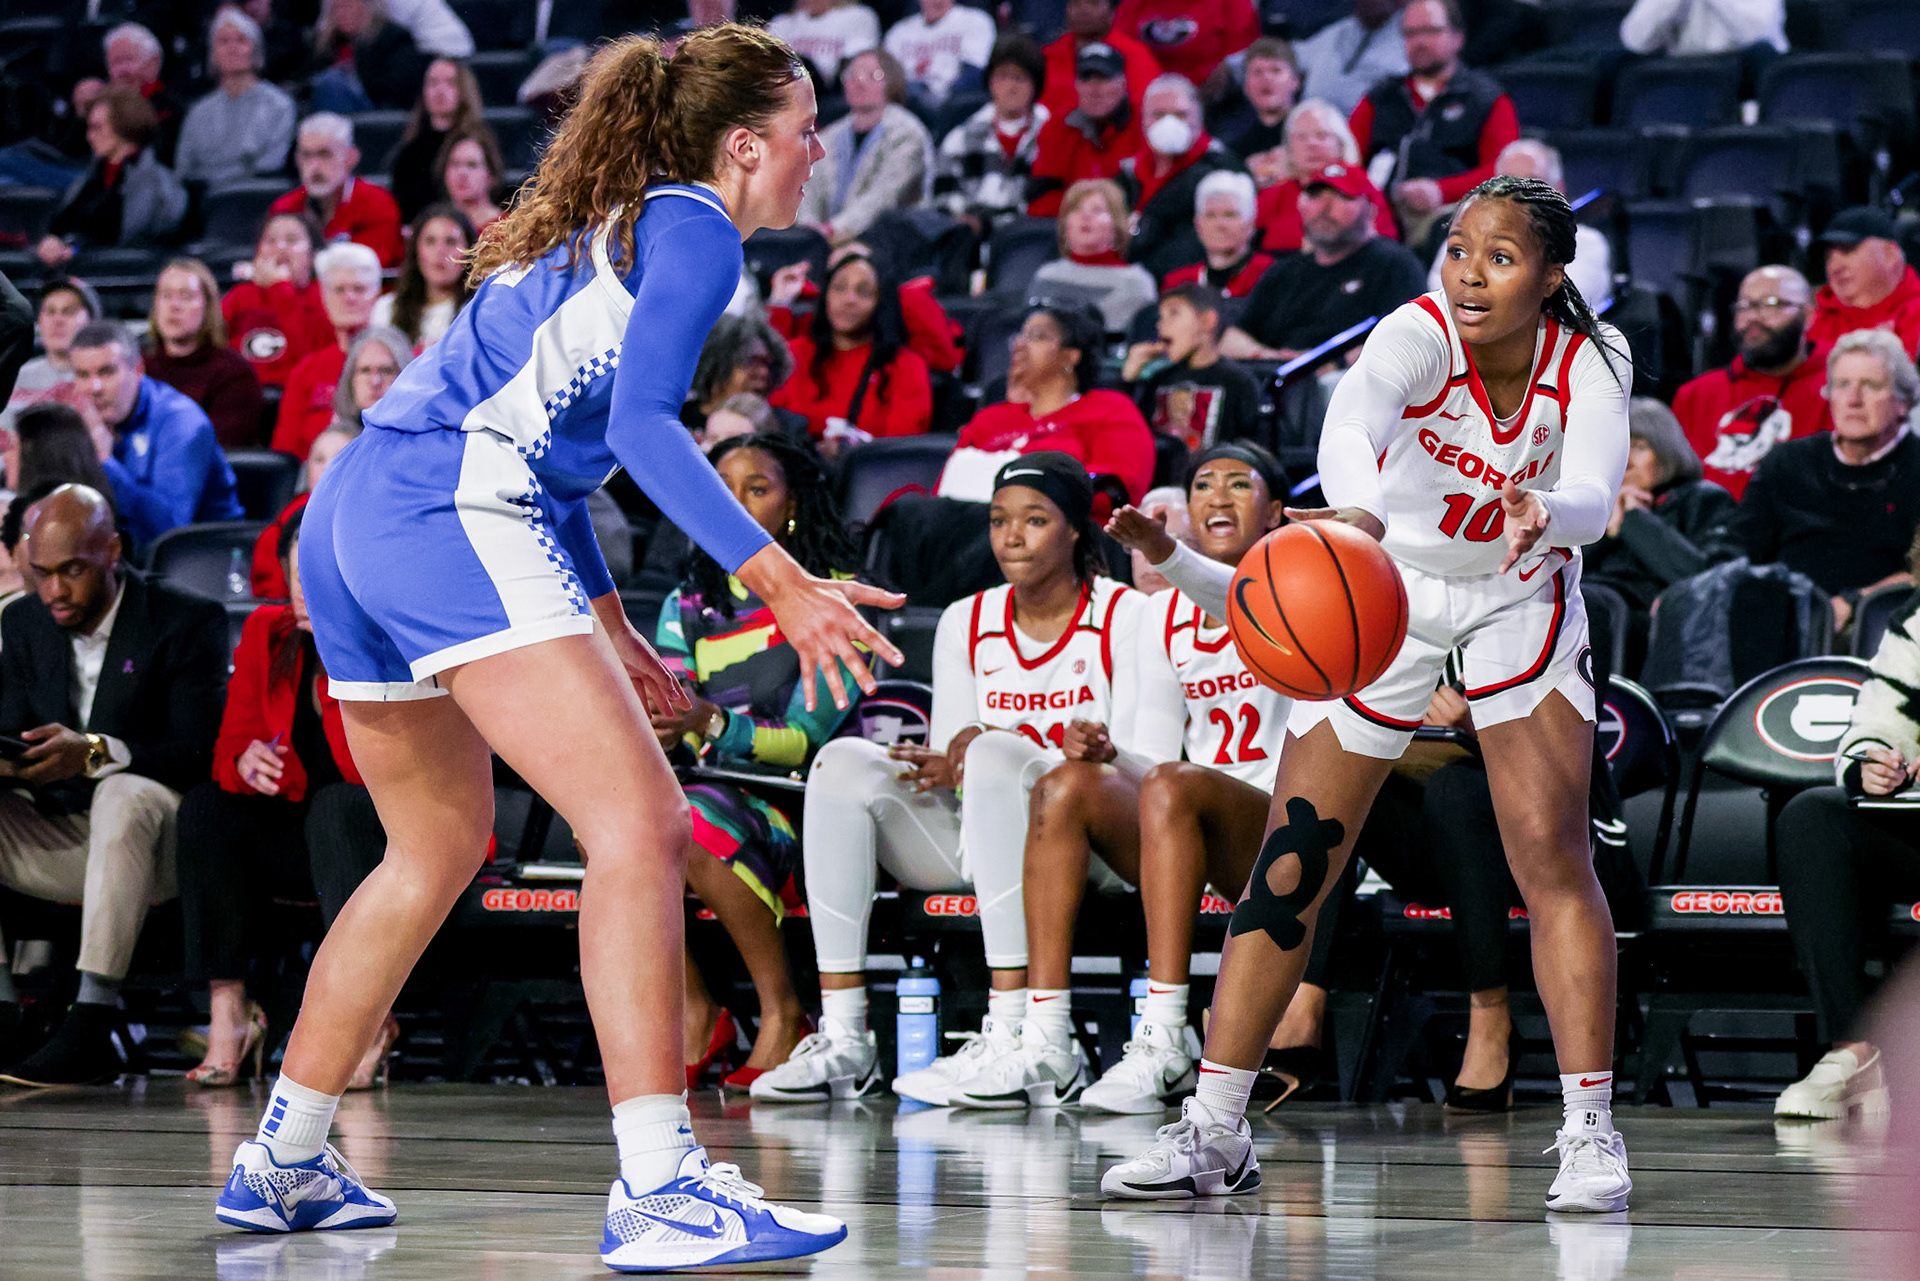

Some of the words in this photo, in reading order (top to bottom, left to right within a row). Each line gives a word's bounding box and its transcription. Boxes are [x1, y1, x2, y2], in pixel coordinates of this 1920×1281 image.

[1533, 427, 1549, 444] SEC
[1438, 493, 1505, 542] 10
[986, 685, 1095, 711] GEORGIA
[1181, 671, 1258, 699] EORG
[1209, 703, 1268, 764] 22
[482, 889, 581, 911] GEORGI
[924, 895, 980, 916] GEO
